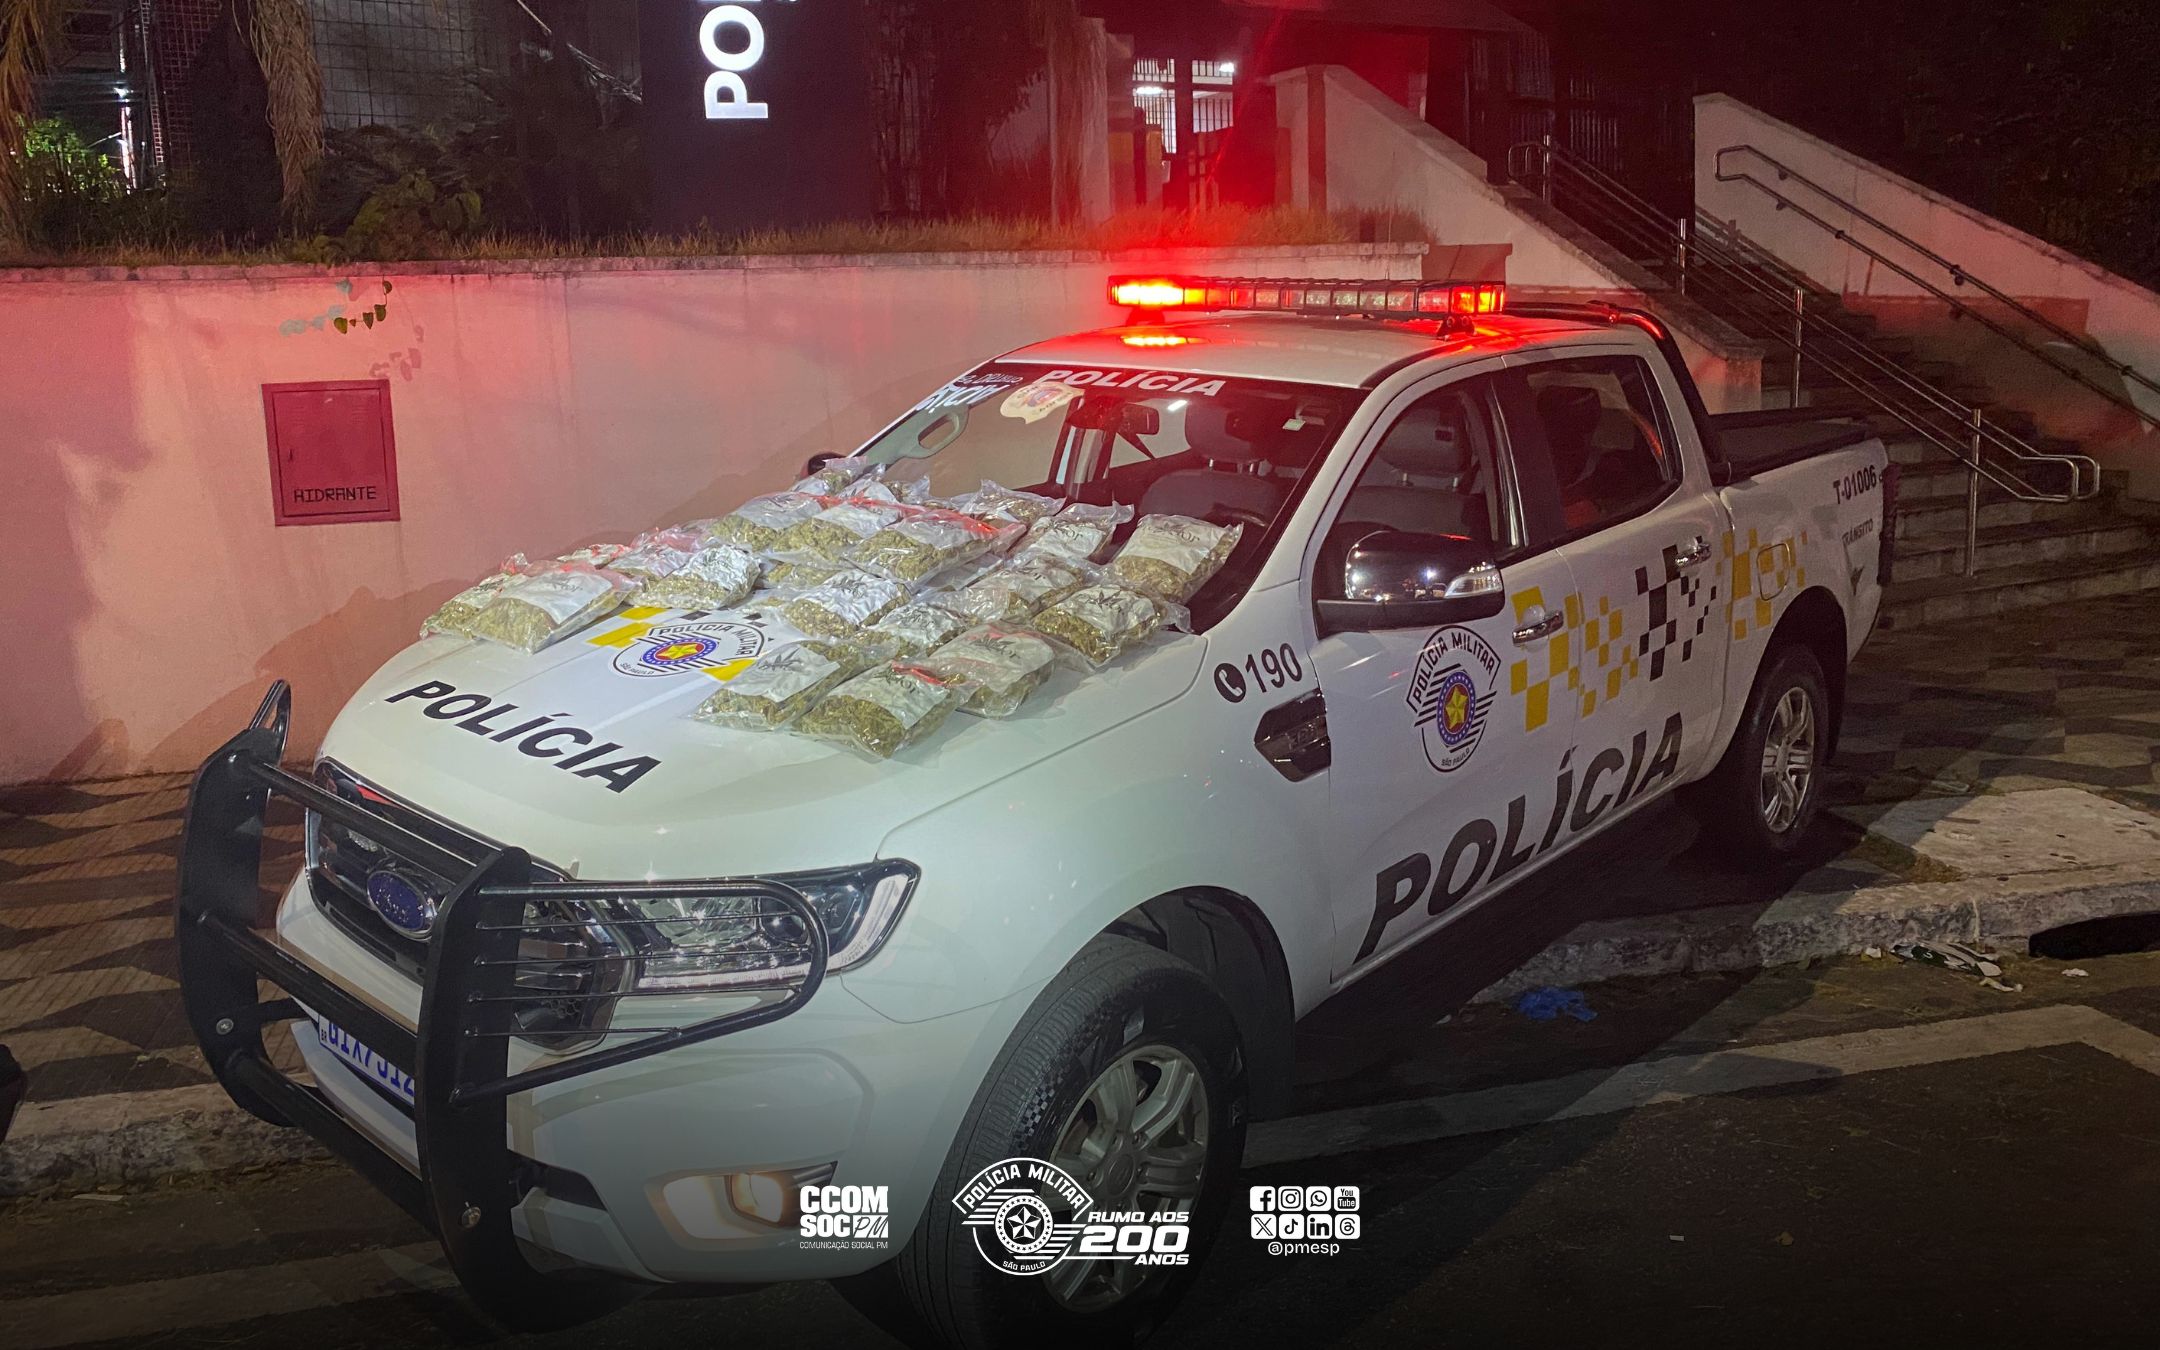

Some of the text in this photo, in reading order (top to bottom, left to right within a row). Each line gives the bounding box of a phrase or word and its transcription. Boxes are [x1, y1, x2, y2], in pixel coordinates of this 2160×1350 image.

[700, 0, 768, 119] PO
[1033, 369, 1226, 397] POLÍCIA
[294, 486, 377, 503] HIDRANTE
[1833, 465, 1877, 504] T-01006
[1245, 643, 1303, 693] 190
[1413, 632, 1496, 704] POLÍCIA MILITAR
[384, 680, 662, 794] POLÍCIA
[1453, 747, 1471, 766] PAULO
[1352, 712, 1683, 966] POLÍCIA
